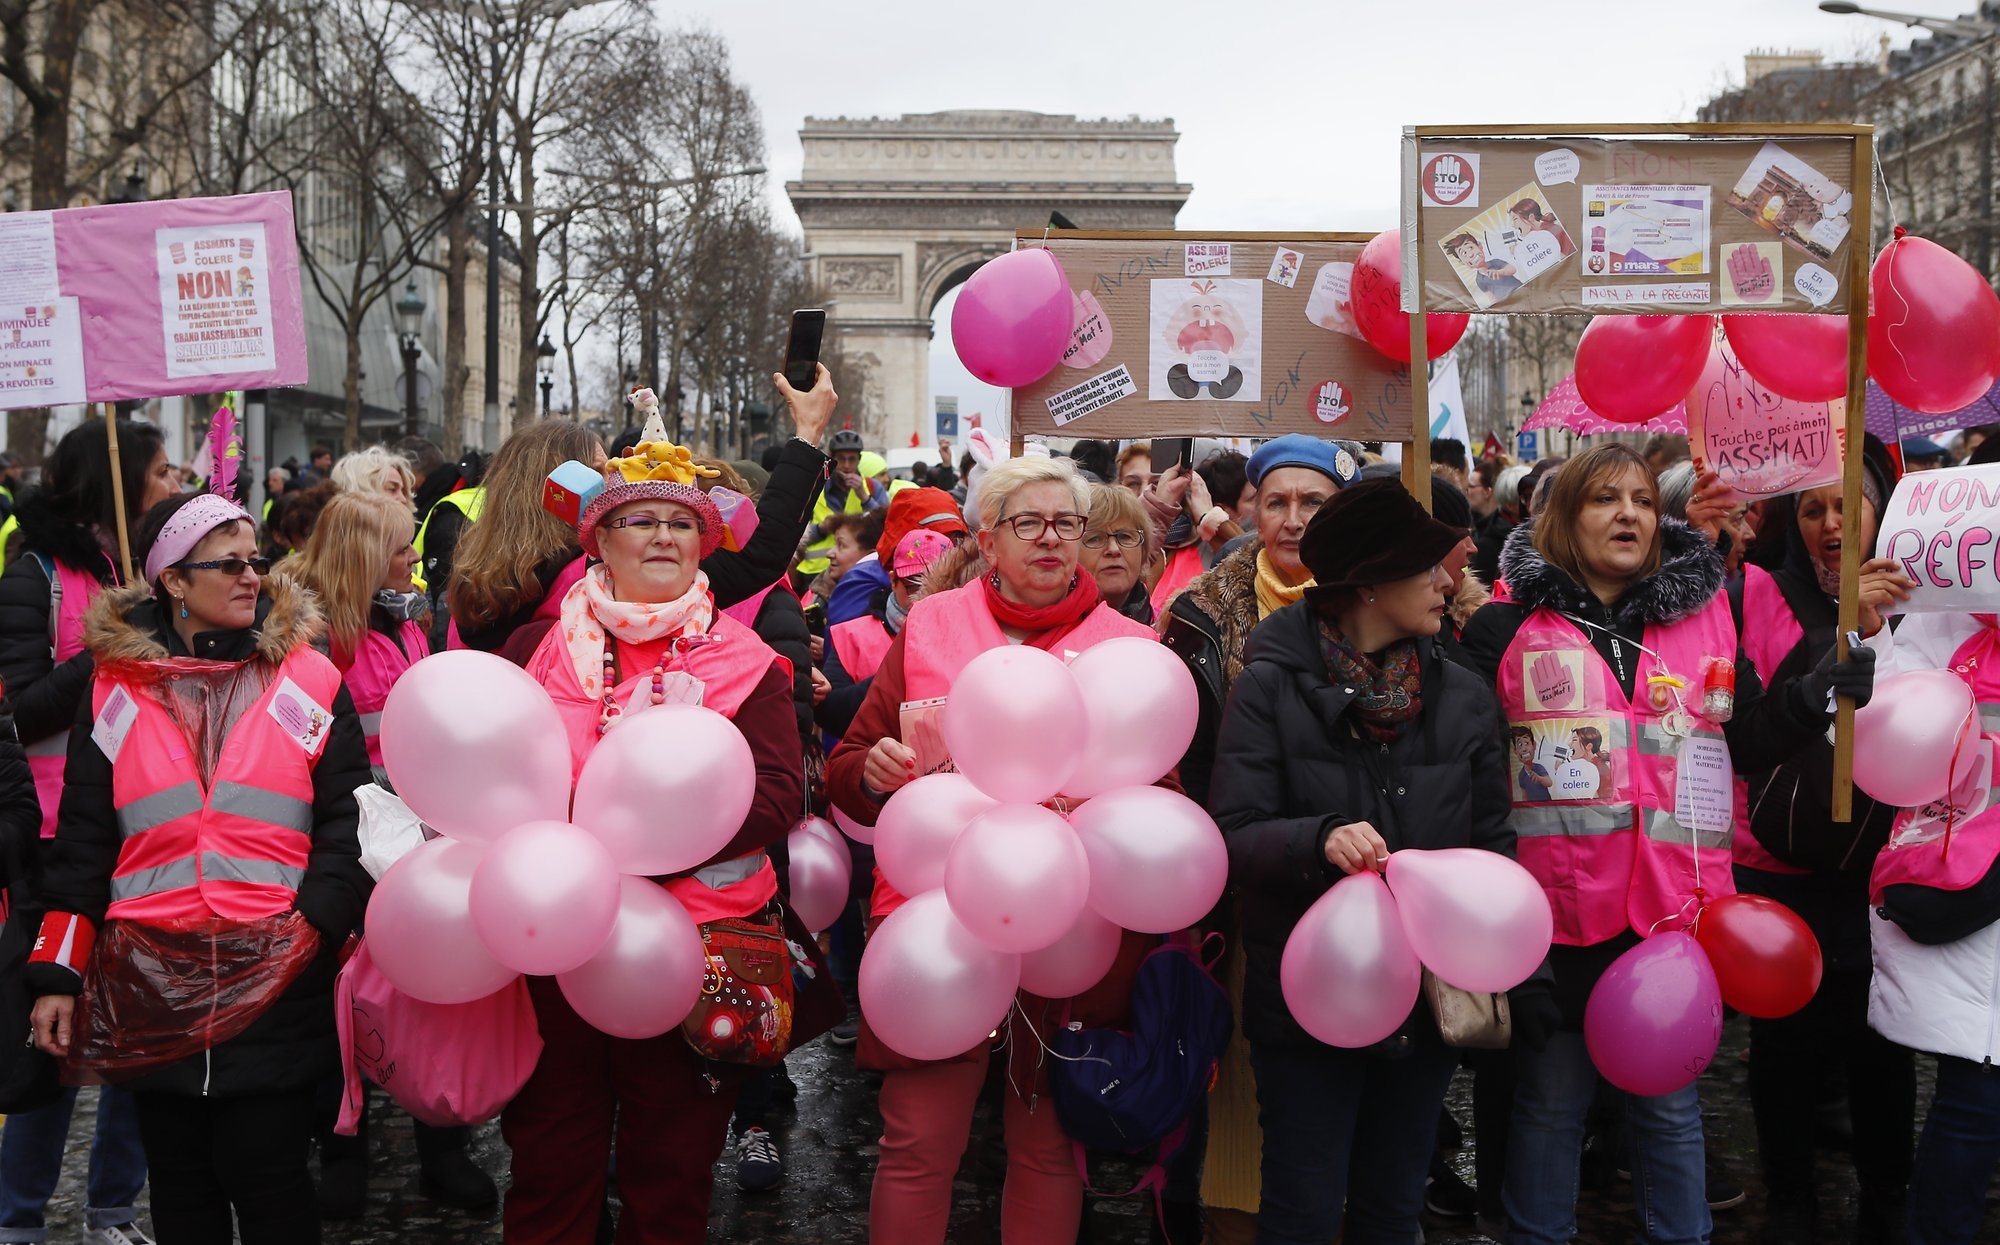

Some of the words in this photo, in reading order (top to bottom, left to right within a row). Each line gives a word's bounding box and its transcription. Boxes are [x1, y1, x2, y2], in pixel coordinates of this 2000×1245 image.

[1612, 152, 1692, 178] NON
[194, 239, 235, 250] ASSMATS
[1188, 246, 1207, 256] ASS
[1208, 245, 1228, 256] MAT
[1526, 242, 1539, 253] En
[195, 255, 233, 266] COLERE
[1188, 255, 1229, 273] COLERE
[1613, 262, 1622, 272] 9
[1624, 261, 1660, 271] mars
[1097, 247, 1171, 295] NON
[1811, 271, 1824, 284] En
[177, 270, 232, 301] NON
[1642, 289, 1657, 300] LA
[173, 332, 199, 343] GRAND
[200, 327, 263, 342] RASSEMBLEMENT
[1079, 326, 1096, 347] Mat
[175, 342, 219, 358] SAMEDI
[221, 341, 229, 354] 9
[231, 338, 263, 353] MARS
[1061, 383, 1091, 402] RÉFORME
[1090, 379, 1100, 388] DU
[1108, 382, 1117, 391] EN
[1116, 376, 1131, 387] CAS
[1250, 352, 1306, 430] NON
[1064, 400, 1099, 421] D'ACTIVITÉ
[1098, 389, 1126, 406] RÉDUITE
[1711, 429, 1764, 448] Touche
[1768, 423, 1791, 446] pas
[1801, 417, 1826, 430] mon
[1524, 435, 1533, 447] P
[1717, 444, 1765, 477] ASS
[1887, 512, 2000, 588] RÉF
[1542, 694, 1552, 702] Ass
[1570, 769, 1581, 777] En
[1921, 806, 1937, 818] Ass
